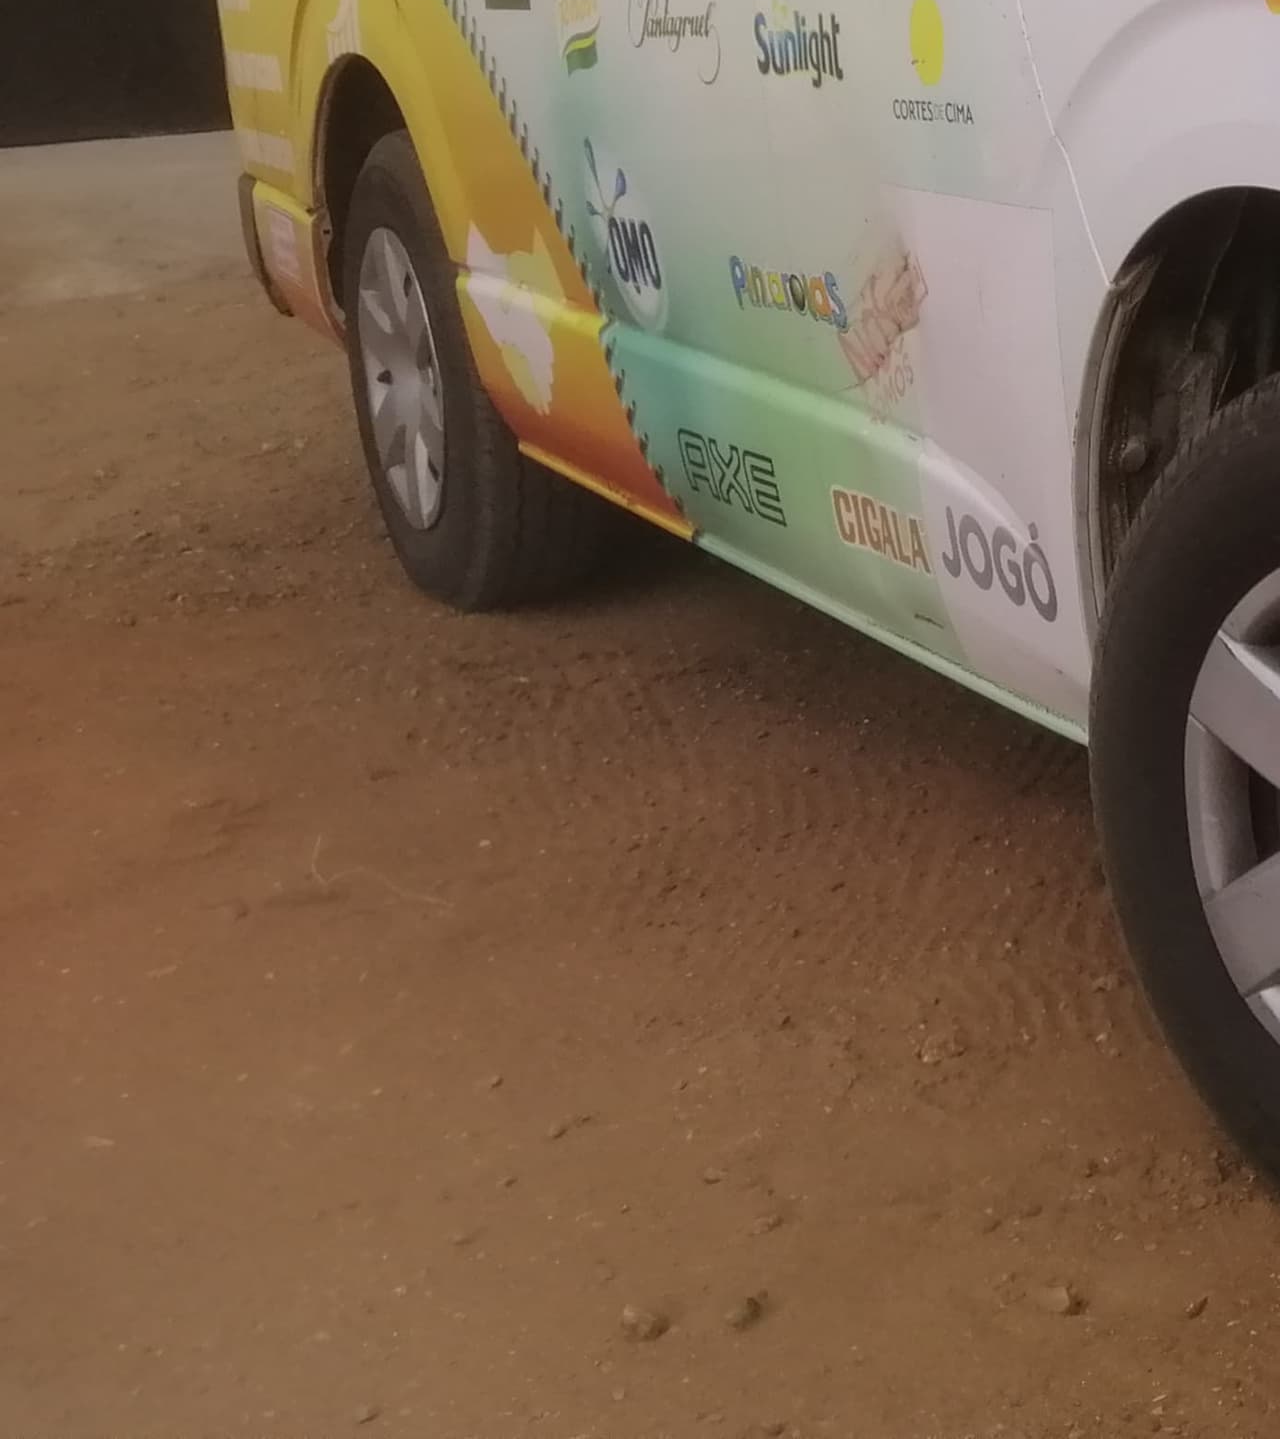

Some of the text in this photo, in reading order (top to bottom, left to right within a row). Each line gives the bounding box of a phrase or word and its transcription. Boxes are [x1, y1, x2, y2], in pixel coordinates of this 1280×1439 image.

[754, 10, 844, 90] Sunlight
[608, 215, 663, 294] OMO
[677, 427, 787, 527] AXE
[831, 486, 931, 574] CIGALA
